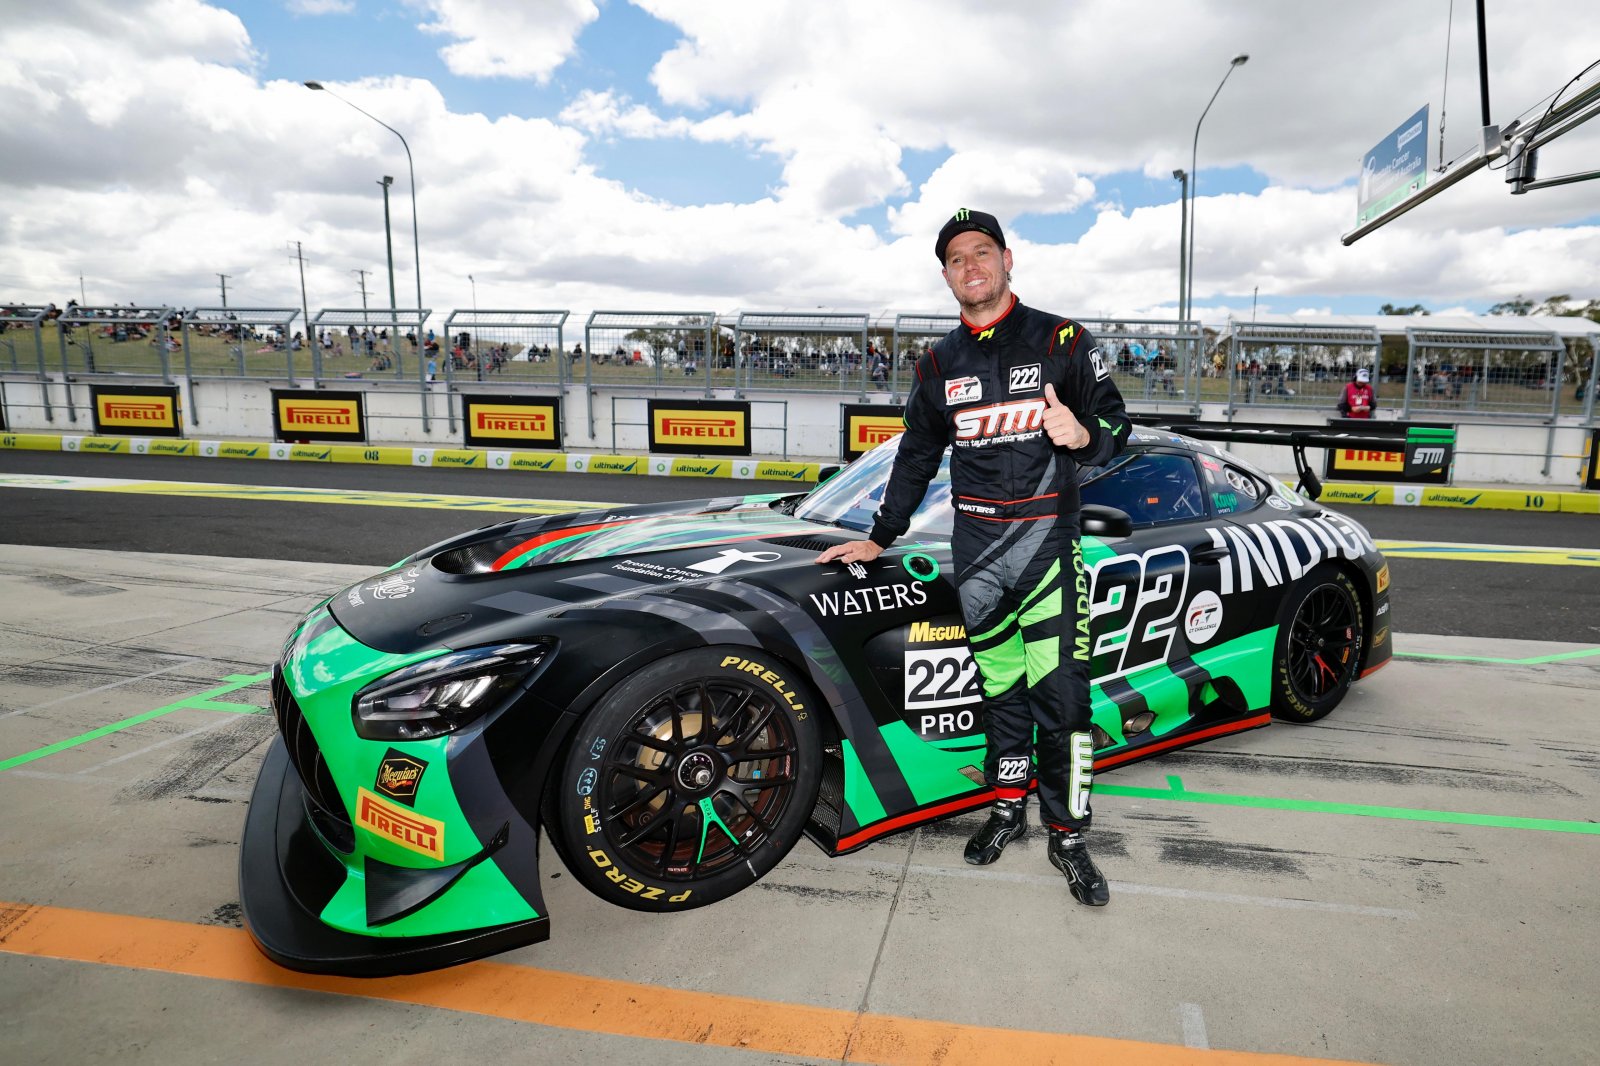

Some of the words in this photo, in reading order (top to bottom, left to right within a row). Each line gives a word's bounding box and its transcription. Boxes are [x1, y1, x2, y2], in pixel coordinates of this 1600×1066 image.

[1010, 367, 1039, 389] 222
[104, 402, 165, 420] PIRELLI
[286, 407, 350, 425] PIRELLI
[477, 412, 545, 431] PIRELLI
[662, 418, 736, 438] PIRELLI
[955, 401, 1047, 440] STM
[3, 436, 17, 447] 07
[971, 438, 991, 448] taylor
[992, 429, 1042, 444] motorsport
[364, 450, 379, 462] 08
[438, 456, 467, 464] ultimate
[513, 459, 543, 468] ultimate
[1412, 448, 1444, 464] STM
[594, 461, 625, 471] ultimate
[676, 465, 708, 474] ultimate
[762, 468, 795, 477] ultimate
[1212, 492, 1237, 512] Kayo
[1327, 490, 1365, 499] ultimate
[1428, 494, 1466, 503] ultimate
[1524, 495, 1544, 508] 10
[958, 503, 996, 514] WATERS
[611, 563, 663, 578] Foundation
[621, 560, 665, 571] Prostate
[666, 567, 704, 578] Cancer
[809, 580, 927, 616] WATERS
[1072, 538, 1090, 661] MADDOX
[908, 622, 967, 642] MEGUIA
[720, 655, 803, 711] PIRELLI
[1280, 667, 1314, 716] PIRELLI
[921, 710, 974, 735] PRO
[381, 764, 419, 783] Meguiar's
[1000, 760, 1027, 780] 222
[361, 796, 437, 852] PIRELLI
[589, 850, 666, 899] ZERO
[668, 889, 693, 902] P
